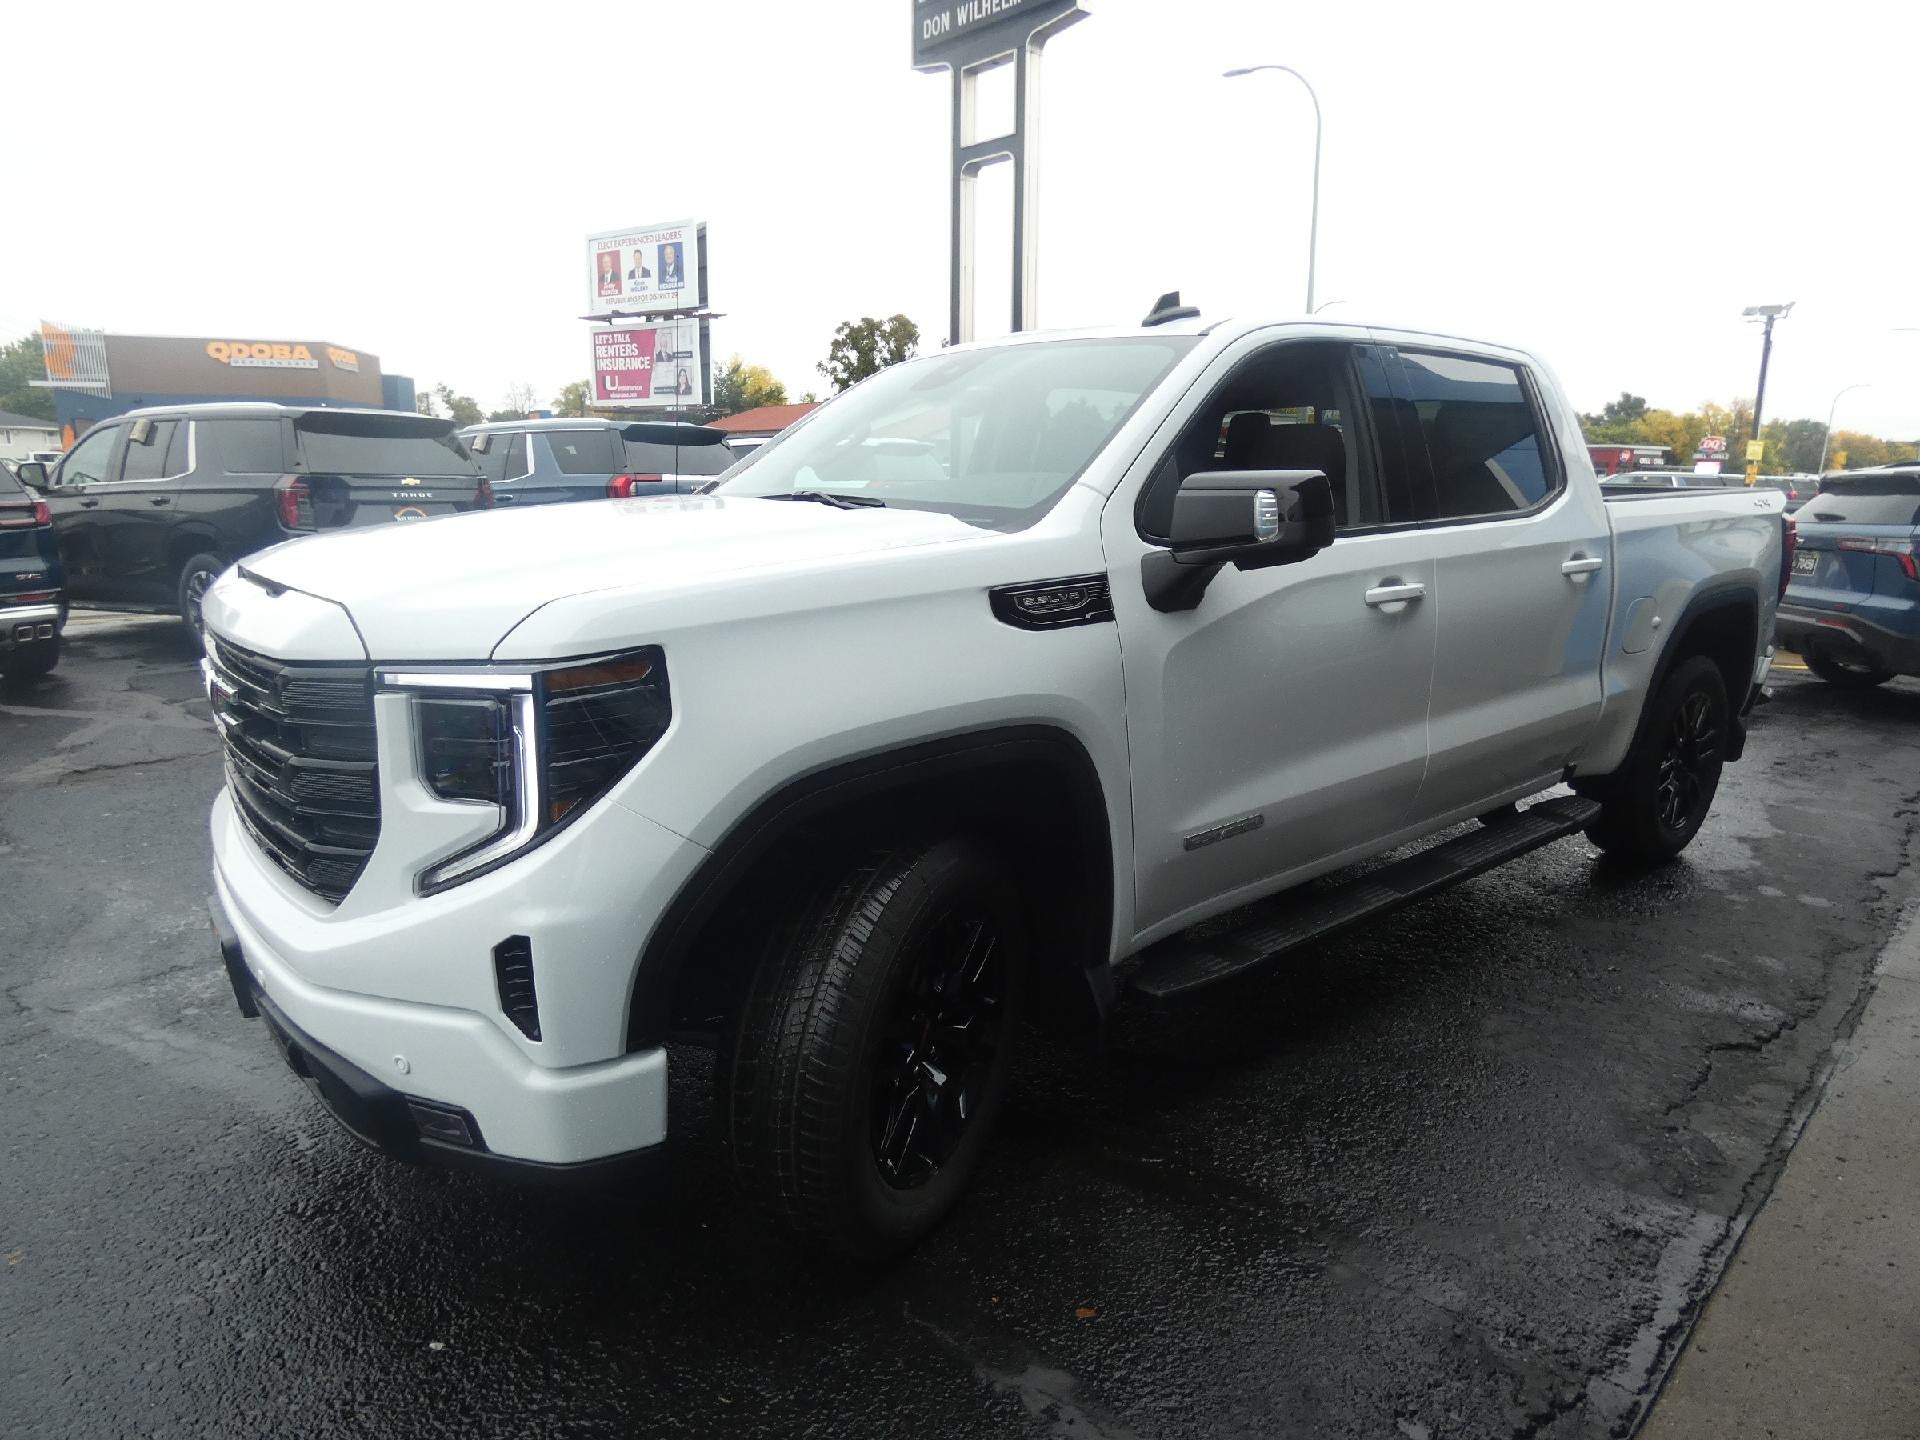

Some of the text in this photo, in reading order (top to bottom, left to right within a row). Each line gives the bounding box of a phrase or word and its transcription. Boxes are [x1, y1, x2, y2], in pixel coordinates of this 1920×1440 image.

[923, 11, 950, 40] DON
[597, 230, 682, 250] ELECT EXPERIENCED LEADERS
[595, 333, 630, 344] LET'S TALK
[207, 341, 312, 364] QDOBA
[596, 343, 639, 358] RENTERS
[597, 356, 651, 371] INSURANCE
